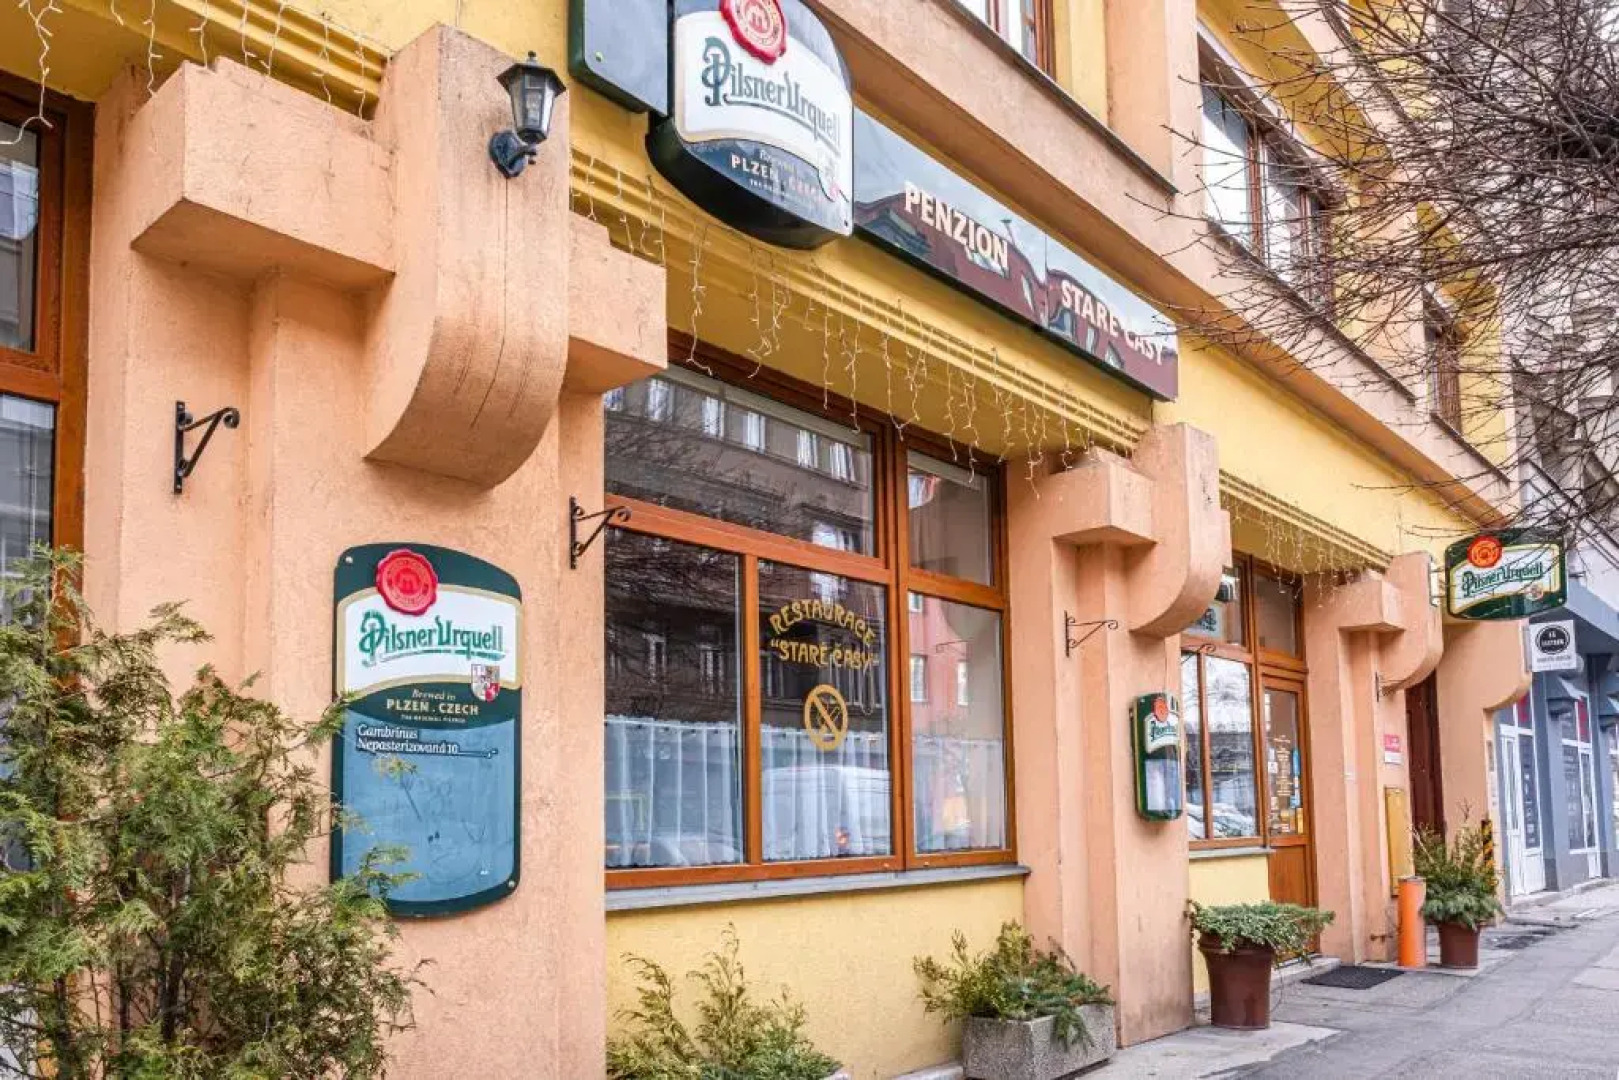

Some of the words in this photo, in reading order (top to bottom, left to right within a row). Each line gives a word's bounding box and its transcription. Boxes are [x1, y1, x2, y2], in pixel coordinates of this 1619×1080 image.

[702, 37, 785, 106] Pilsner
[784, 71, 840, 146] Urquell
[904, 180, 1008, 269] PENZION
[1462, 570, 1501, 598] Pilsner
[1500, 562, 1543, 582] Urquell
[359, 610, 436, 668] Pilsner
[435, 615, 503, 660] Urquell
[769, 599, 877, 647] RESTAURACE
[386, 699, 430, 712] PLZEN
[439, 703, 479, 716] CZECH
[358, 724, 418, 740] Gambrinus
[447, 743, 459, 754] 10
